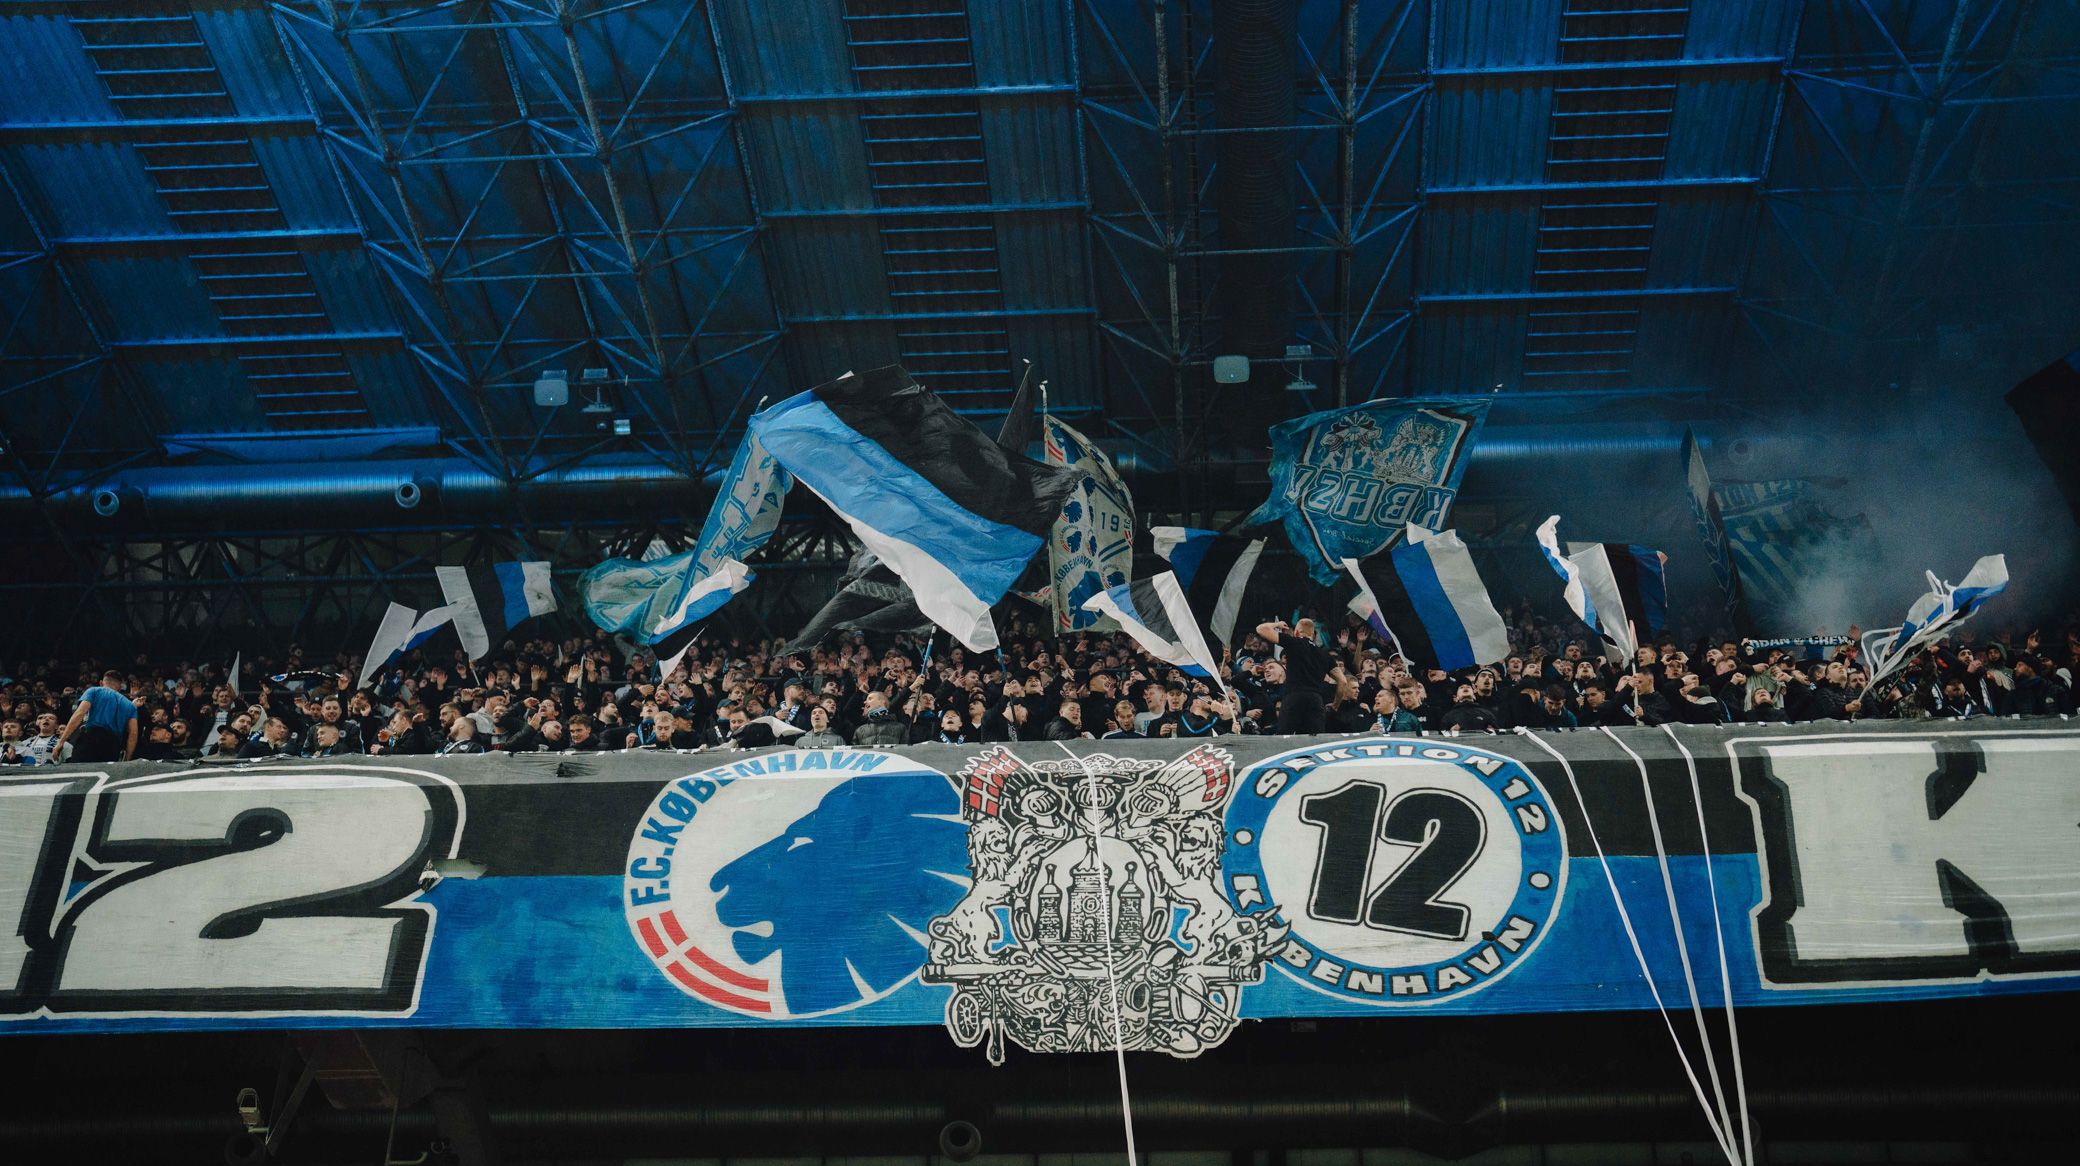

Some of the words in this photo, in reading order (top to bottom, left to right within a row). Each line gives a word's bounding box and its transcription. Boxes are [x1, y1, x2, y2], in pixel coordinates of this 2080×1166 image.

[1254, 743, 1505, 798] SEKTION
[1502, 776, 1548, 834] 12
[1300, 779, 1488, 941] 12
[1232, 874, 1537, 996] KBENHAVN
